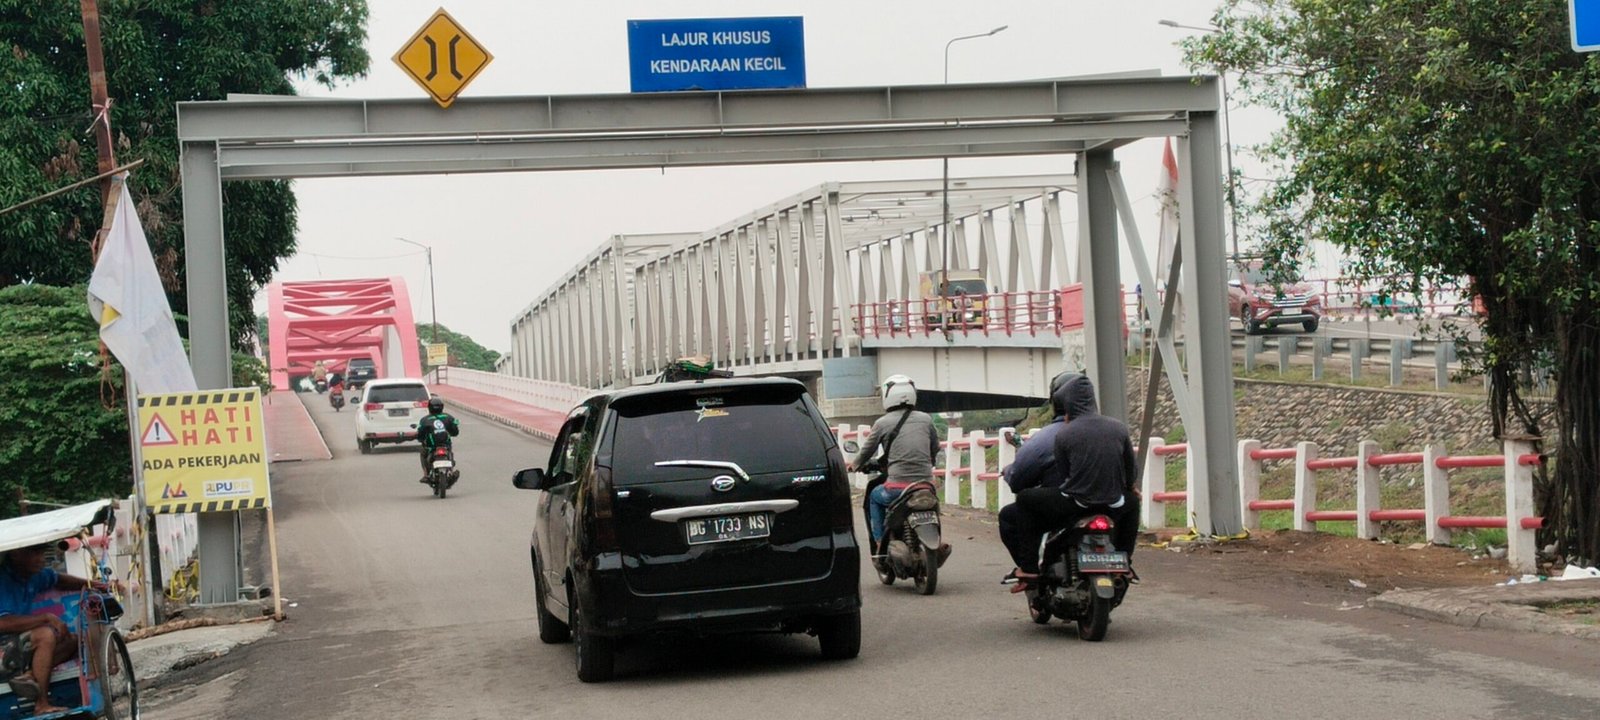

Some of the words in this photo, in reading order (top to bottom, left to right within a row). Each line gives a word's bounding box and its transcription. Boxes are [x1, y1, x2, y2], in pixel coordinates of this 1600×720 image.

[661, 32, 709, 46] LAJUR
[713, 30, 771, 45] KHUSUS
[651, 58, 741, 73] KENDARAAN
[744, 57, 786, 71] KECIL
[180, 406, 250, 425] HATI
[182, 426, 253, 446] HATI
[143, 458, 174, 471] ADA
[178, 453, 261, 469] PEKERJAAN
[688, 520, 706, 537] BG
[714, 517, 741, 533] 1733
[748, 515, 765, 530] NS
